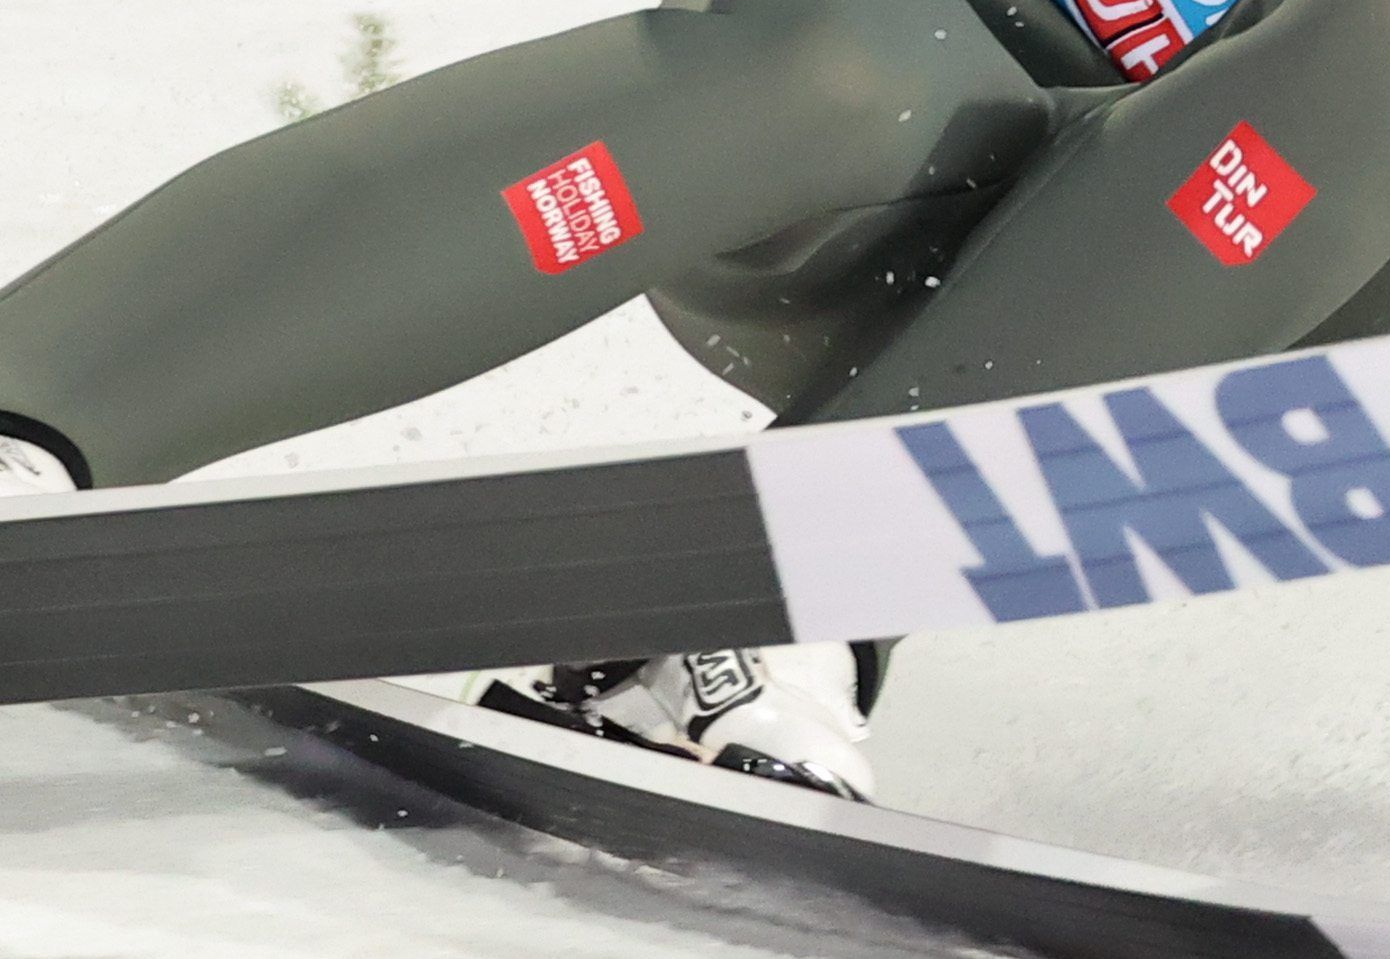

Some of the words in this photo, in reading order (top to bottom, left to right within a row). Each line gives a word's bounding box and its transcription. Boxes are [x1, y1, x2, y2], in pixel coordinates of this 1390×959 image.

[547, 169, 600, 252] HOLIDAY
[566, 157, 621, 245] FISHING
[1209, 138, 1268, 208] DIN
[526, 178, 580, 263] NORWAY
[1202, 178, 1263, 258] TUR
